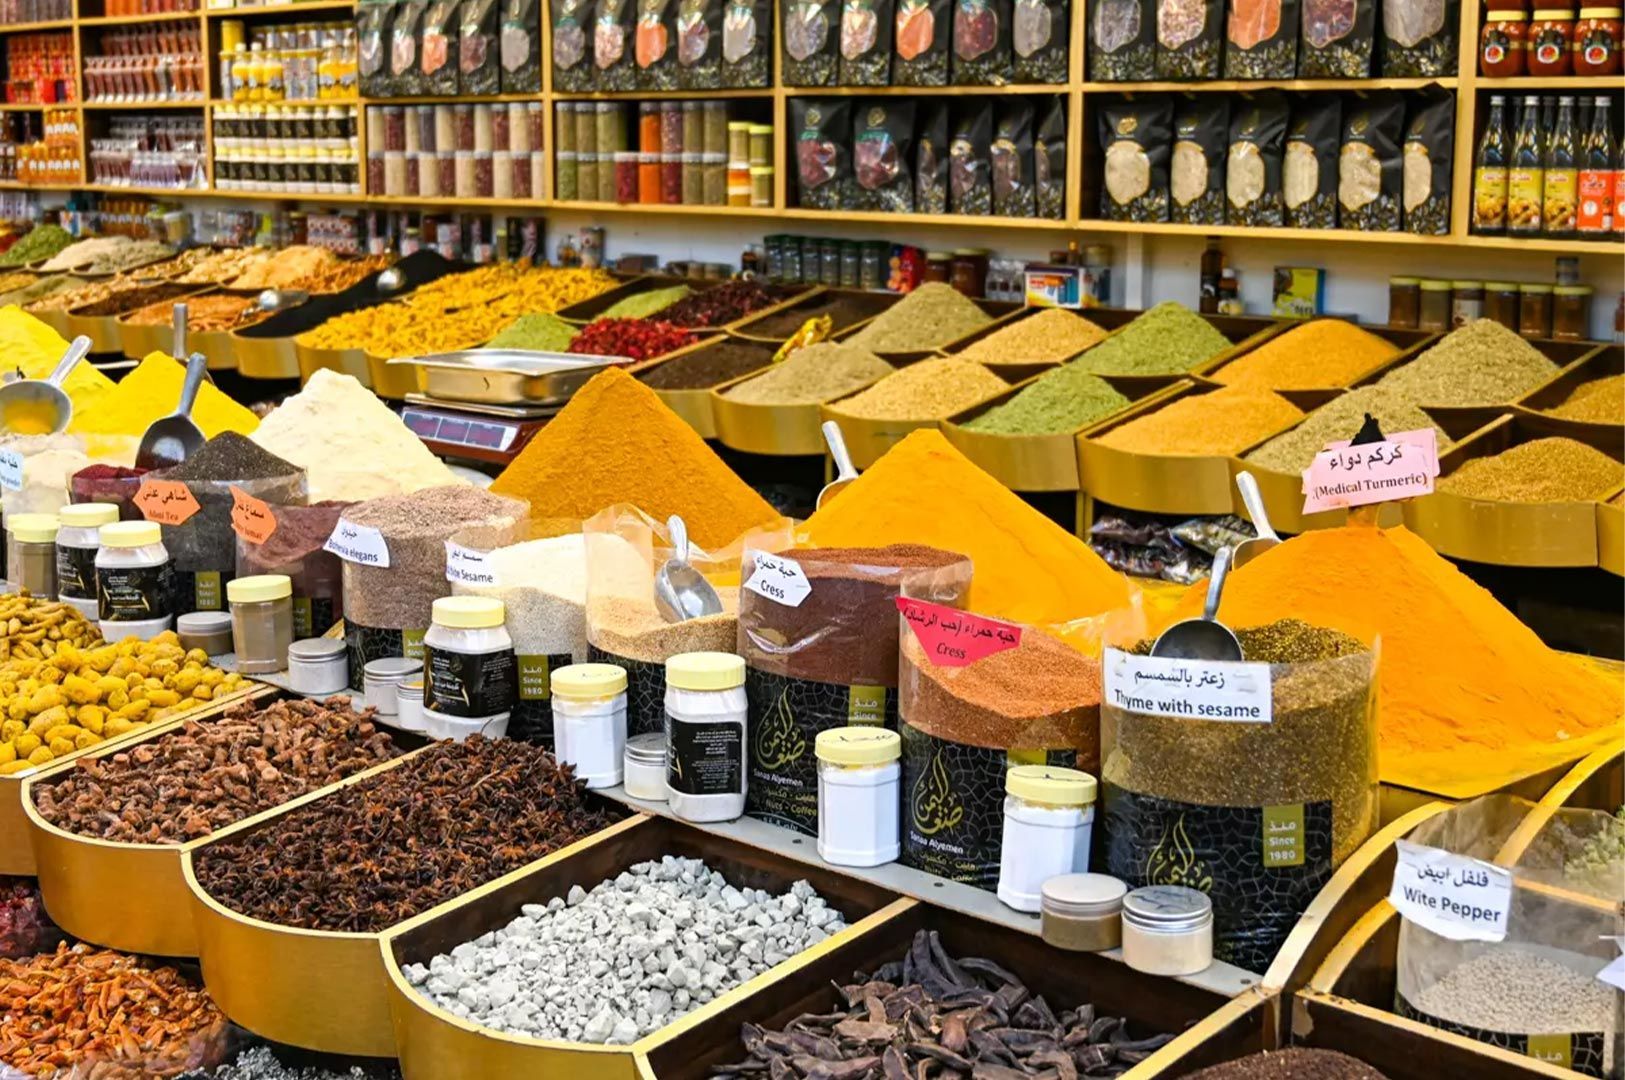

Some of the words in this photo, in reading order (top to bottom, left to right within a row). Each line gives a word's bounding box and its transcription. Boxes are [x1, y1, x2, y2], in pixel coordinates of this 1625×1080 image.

[1329, 452, 1362, 471] دواء
[1366, 444, 1402, 470] كركم
[1364, 472, 1428, 491] Turmeric)
[349, 548, 379, 563] elegans
[460, 568, 494, 583] Sesame
[760, 579, 785, 599] Cress
[936, 642, 966, 659] Cress
[1134, 667, 1193, 688] بالسمسم
[1195, 670, 1226, 689] زعتر
[523, 687, 543, 695] 1980
[1114, 688, 1154, 710] Thyme
[1158, 699, 1193, 715] with
[1197, 703, 1261, 718] sesame
[928, 838, 964, 855] Alyemen
[1269, 837, 1296, 846] Since
[1269, 851, 1296, 860] 1980
[1453, 869, 1489, 887] فلفل
[1403, 884, 1437, 908] Wite
[1441, 896, 1501, 922] Pepper
